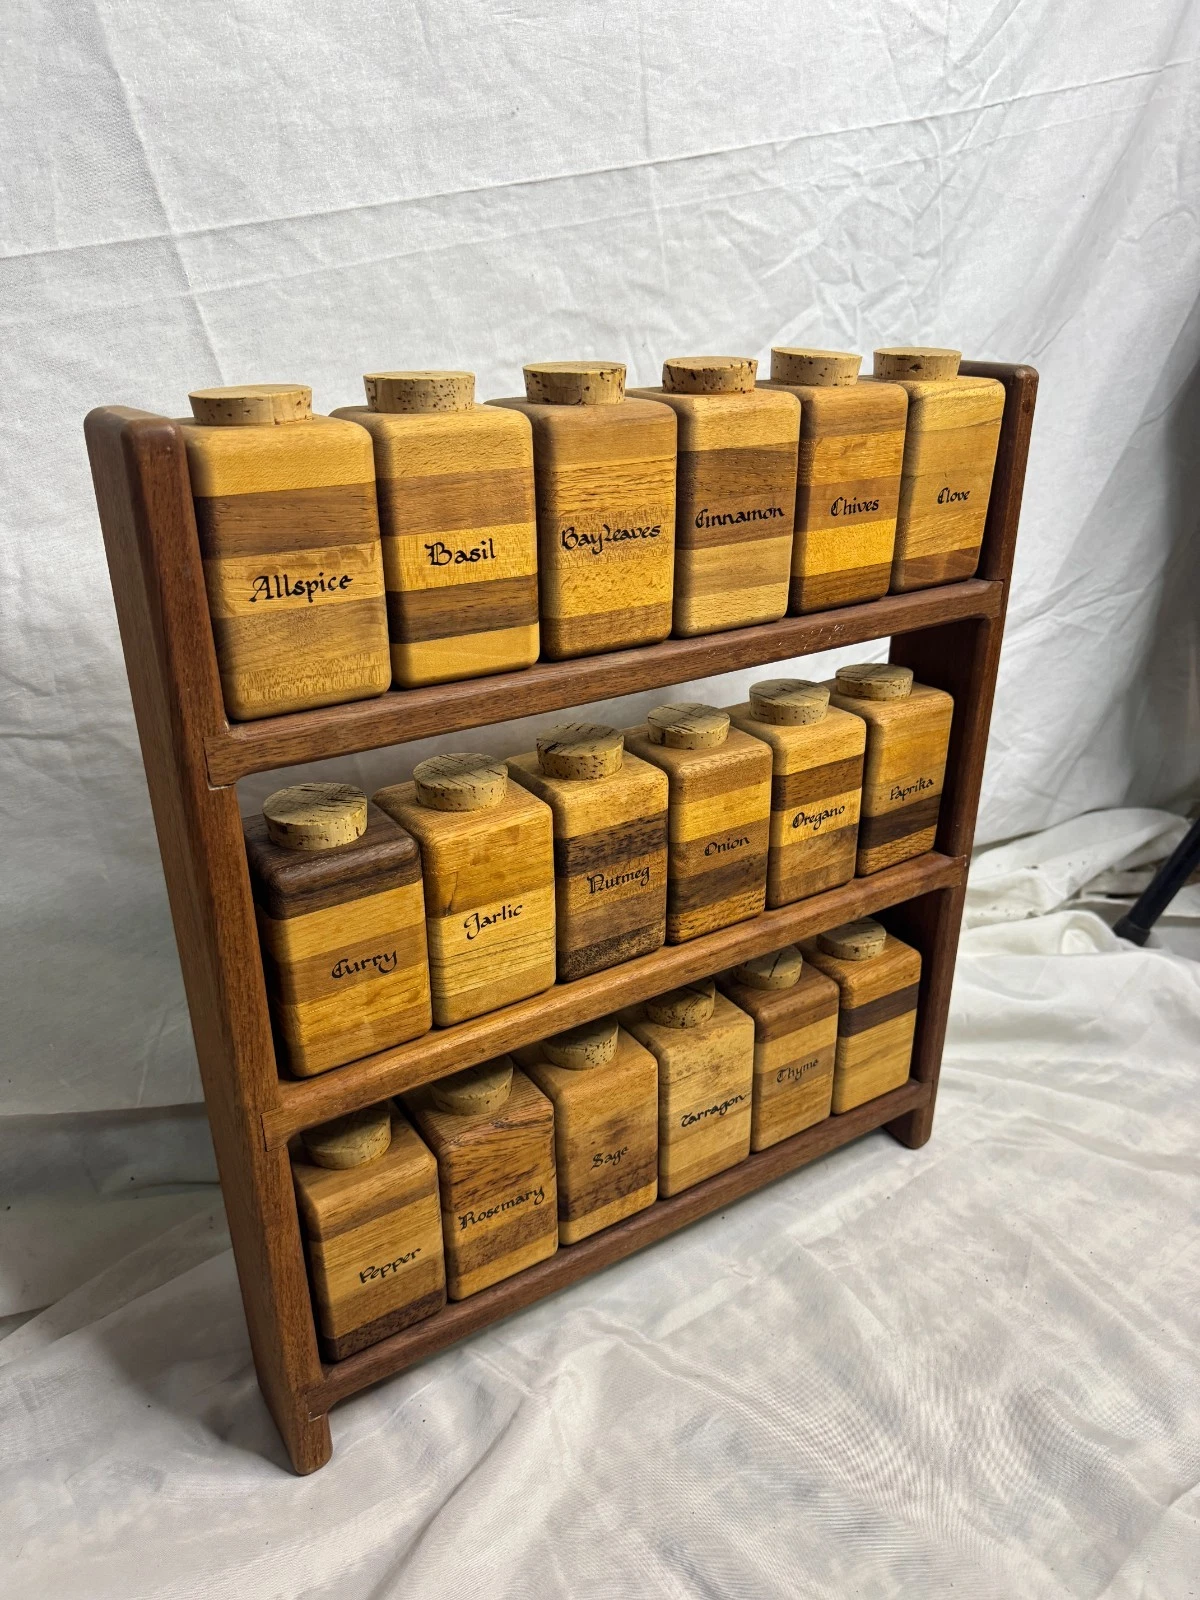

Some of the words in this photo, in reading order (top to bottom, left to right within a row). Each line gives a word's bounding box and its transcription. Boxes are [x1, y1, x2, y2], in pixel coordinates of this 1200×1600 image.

[830, 497, 880, 517] Chives
[937, 487, 971, 505] Clove
[694, 505, 785, 528] Cinnamon
[424, 538, 497, 566] Basil
[249, 571, 353, 602] Allspice
[889, 777, 935, 801] Paprika
[792, 804, 846, 830] Oregano
[704, 834, 750, 857] Onion
[587, 865, 650, 895] Nutmeg
[463, 903, 523, 940] Garlic
[331, 950, 398, 979] Curry
[776, 1057, 819, 1083] Thyme
[681, 1091, 750, 1128] Tarragon
[590, 1146, 629, 1170] Sage
[458, 1185, 545, 1231] Rosemary
[359, 1247, 421, 1284] Pepper
